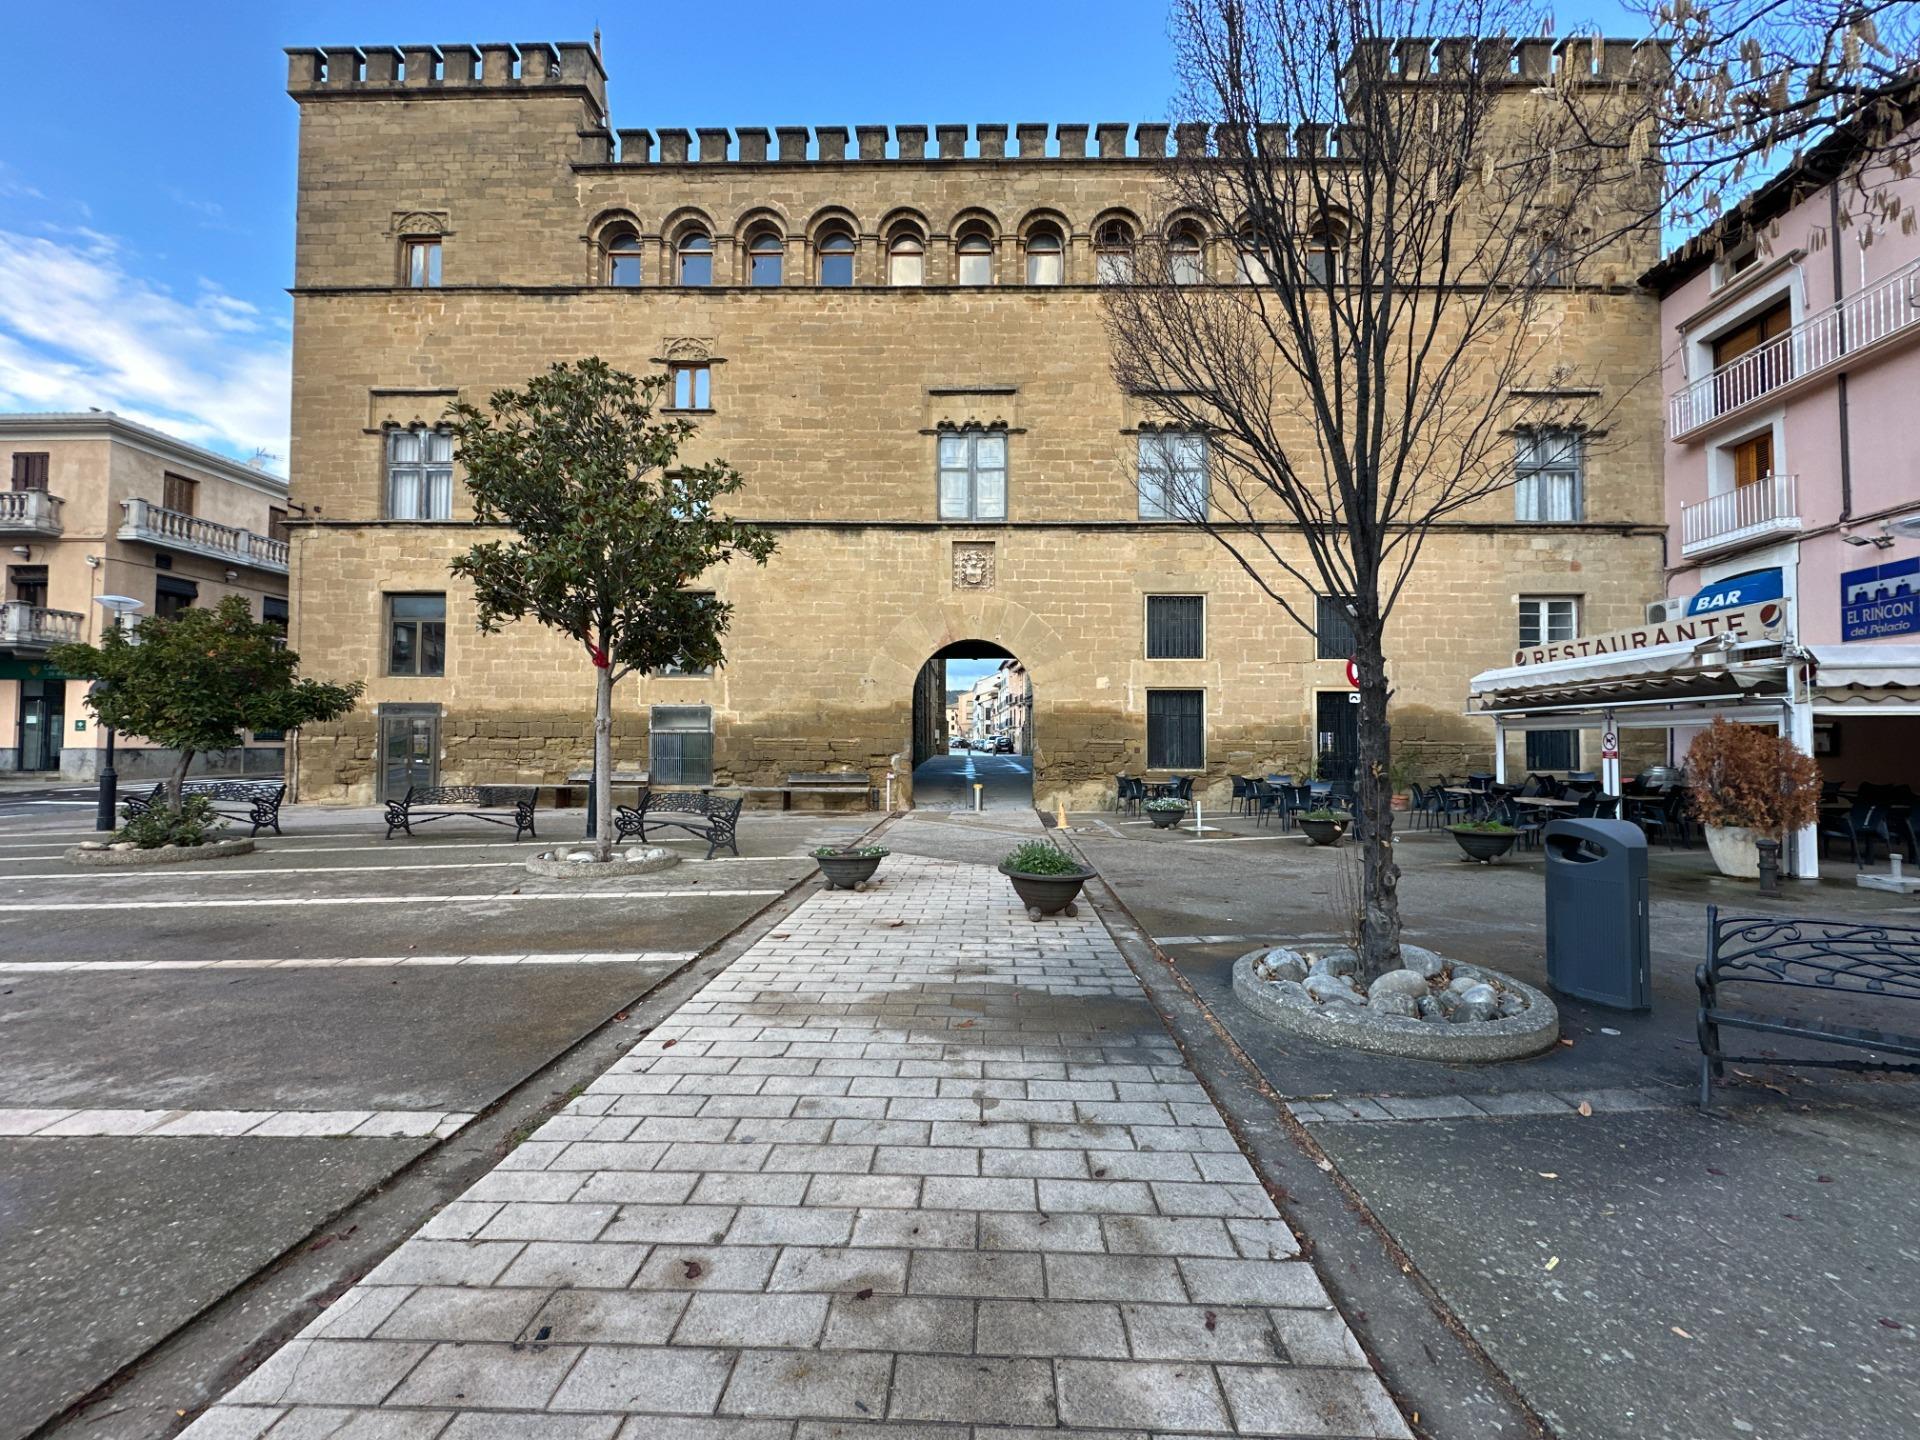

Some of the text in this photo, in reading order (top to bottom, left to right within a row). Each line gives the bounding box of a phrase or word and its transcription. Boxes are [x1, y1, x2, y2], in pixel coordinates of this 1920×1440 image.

[1696, 590, 1741, 611] BAR
[1847, 601, 1914, 625] EL RINCON
[1532, 613, 1748, 664] RESTAURANTE
[1850, 621, 1910, 637] del Palacio
